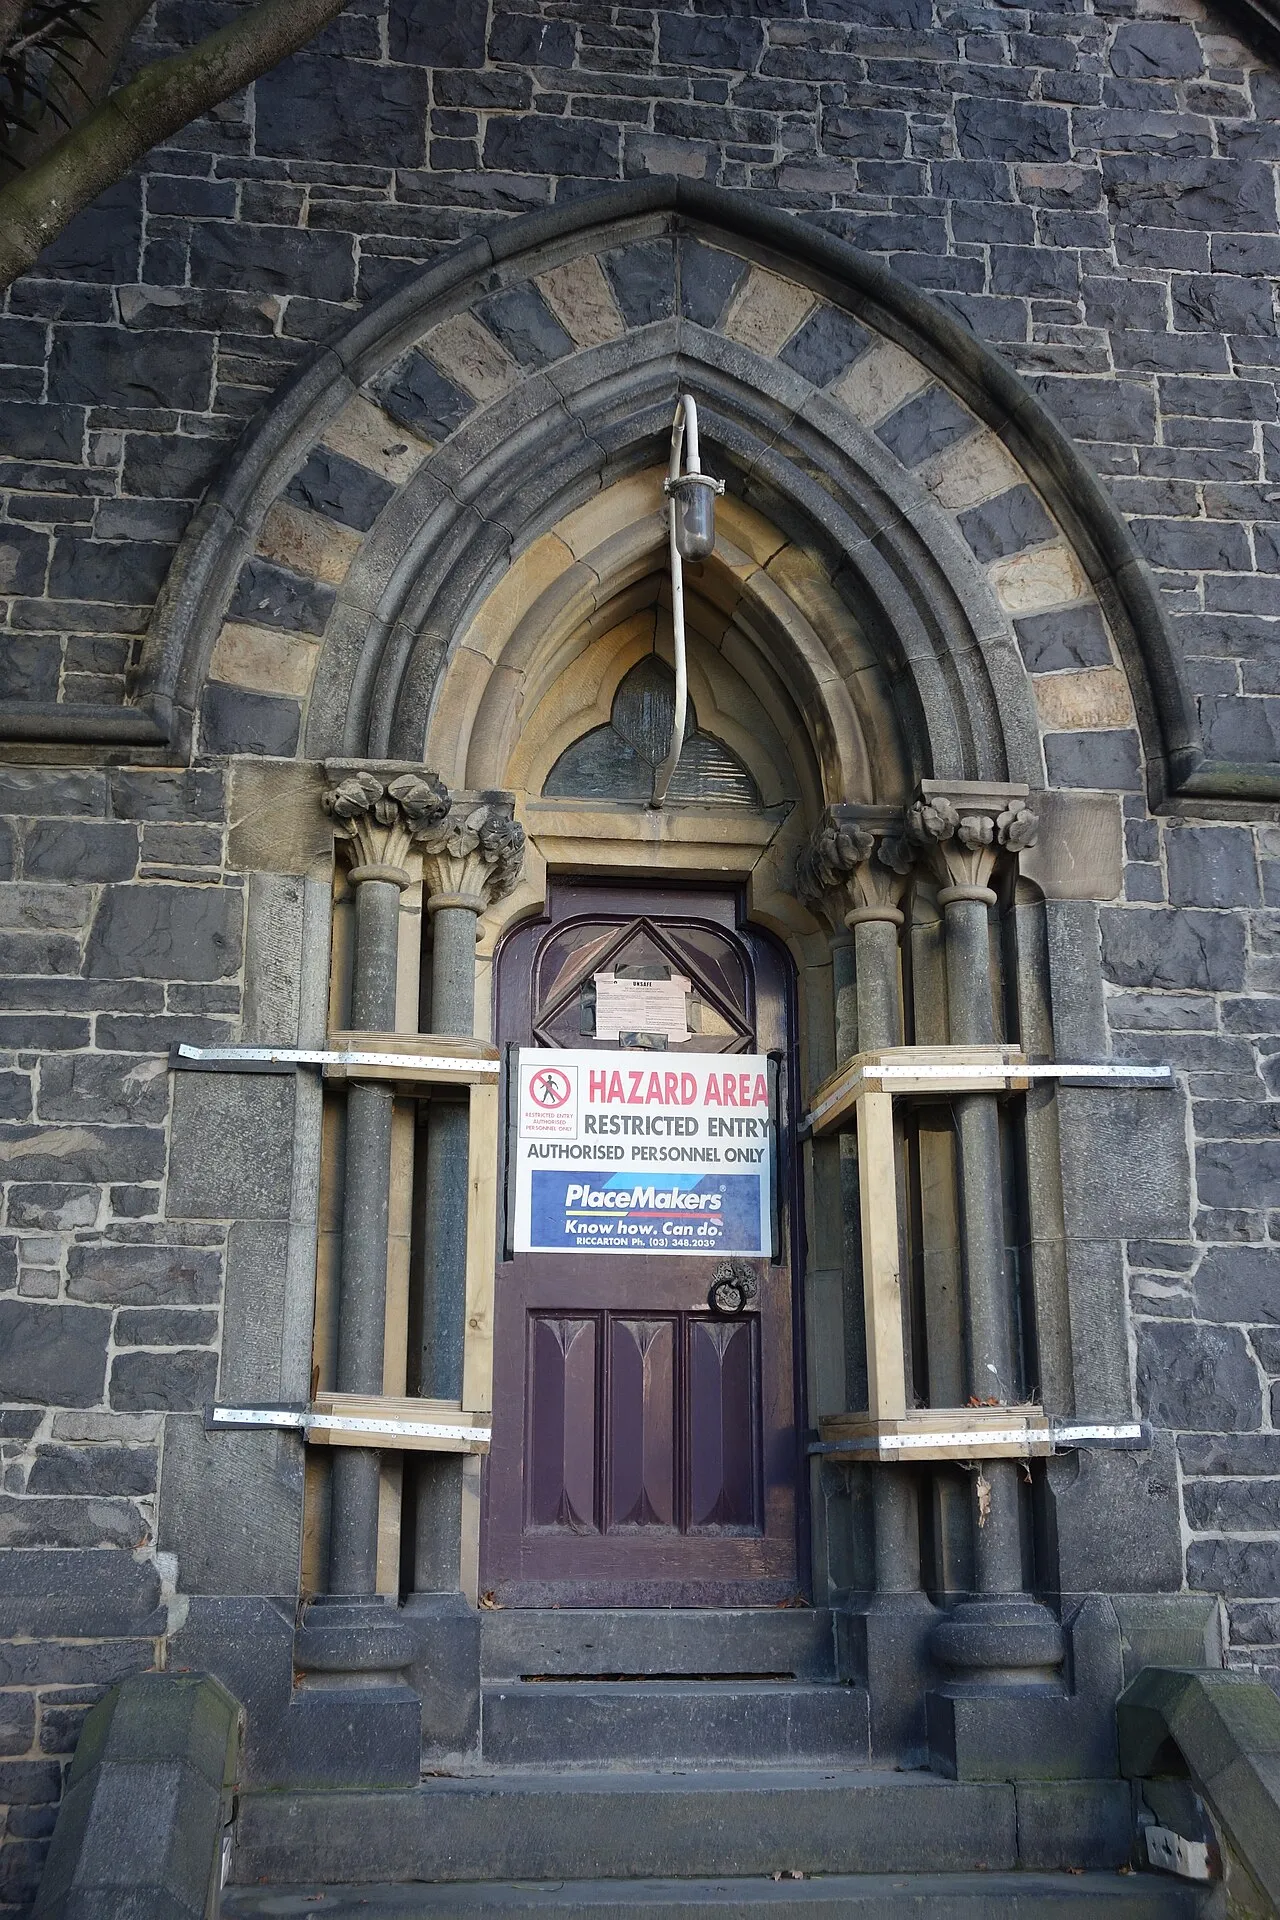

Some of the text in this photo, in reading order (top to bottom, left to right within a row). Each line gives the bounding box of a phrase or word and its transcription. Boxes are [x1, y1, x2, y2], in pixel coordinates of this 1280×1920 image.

[589, 1070, 769, 1107] HAZARD AREA
[584, 1114, 770, 1138] RESTRICTED ENTRY
[527, 1143, 765, 1163] AUTHORISED PERSONNEL ONLY
[565, 1184, 722, 1210] PlaceMakers
[565, 1219, 723, 1236] Know how. Can do.
[576, 1237, 716, 1247] RICCARTON Ph. (03) 348.2039
